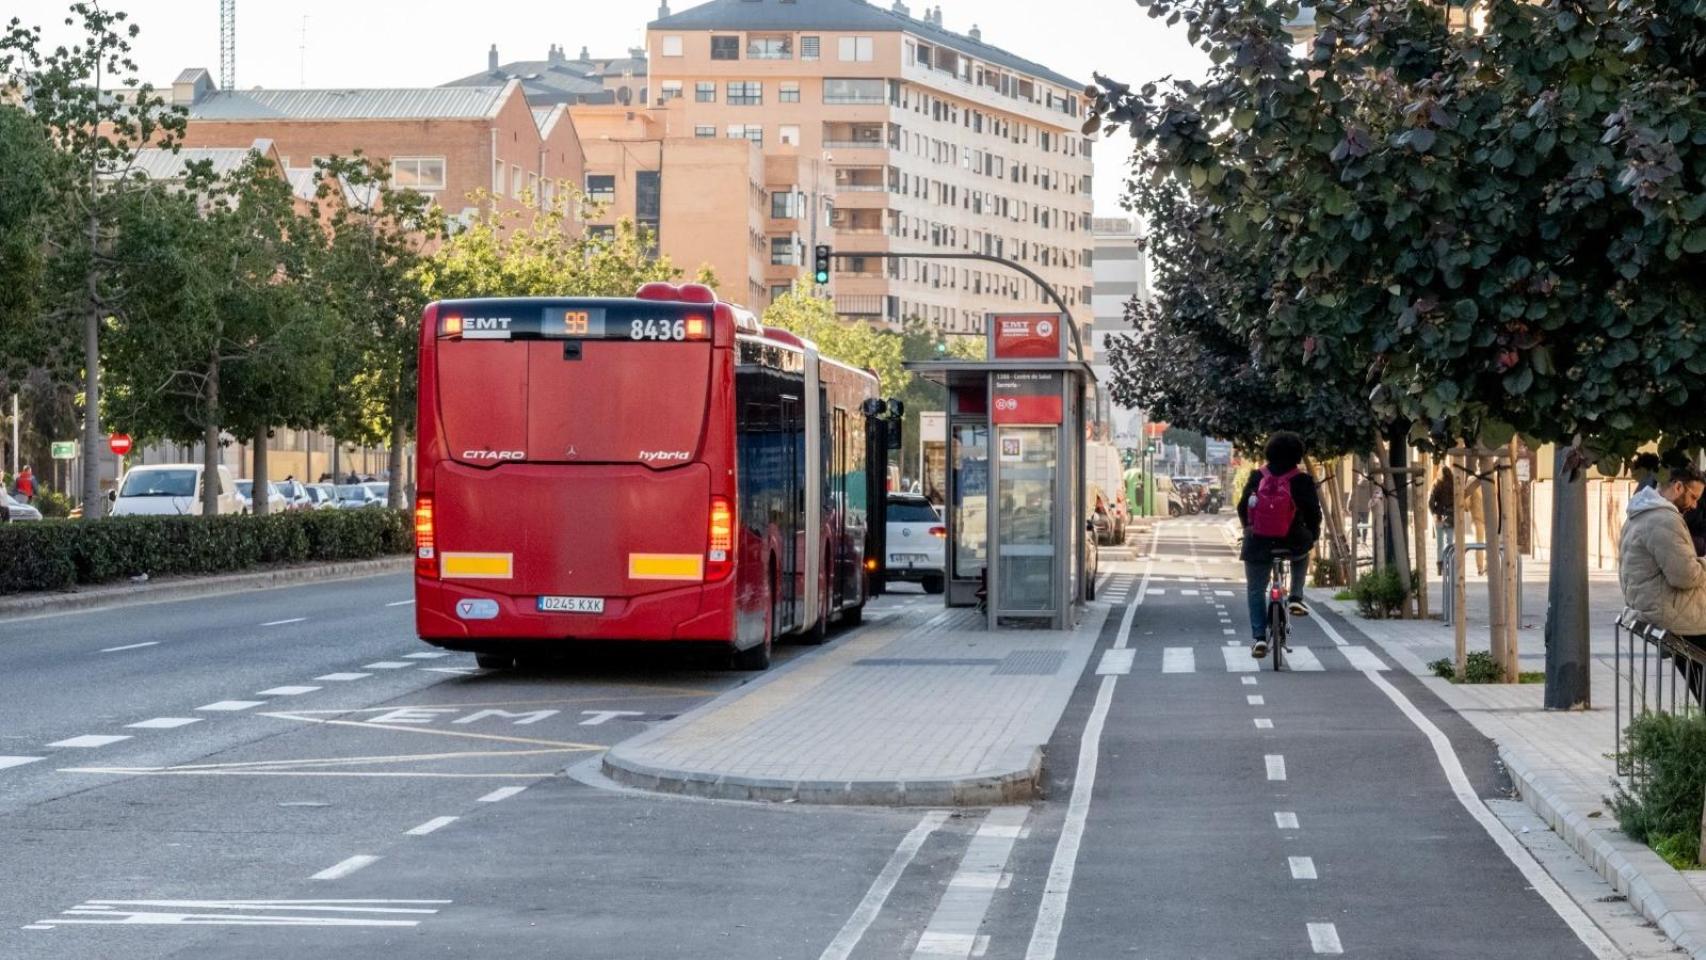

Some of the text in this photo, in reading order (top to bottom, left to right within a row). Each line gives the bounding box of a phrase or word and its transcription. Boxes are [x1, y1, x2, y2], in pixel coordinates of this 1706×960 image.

[462, 317, 512, 330] EMT
[565, 311, 589, 335] 99
[1002, 321, 1029, 329] EMT
[630, 319, 686, 341] 8436
[462, 449, 525, 460] CITARO
[638, 450, 690, 462] hybrid
[545, 598, 601, 611] 0245 KXK
[367, 708, 644, 726] EMT
